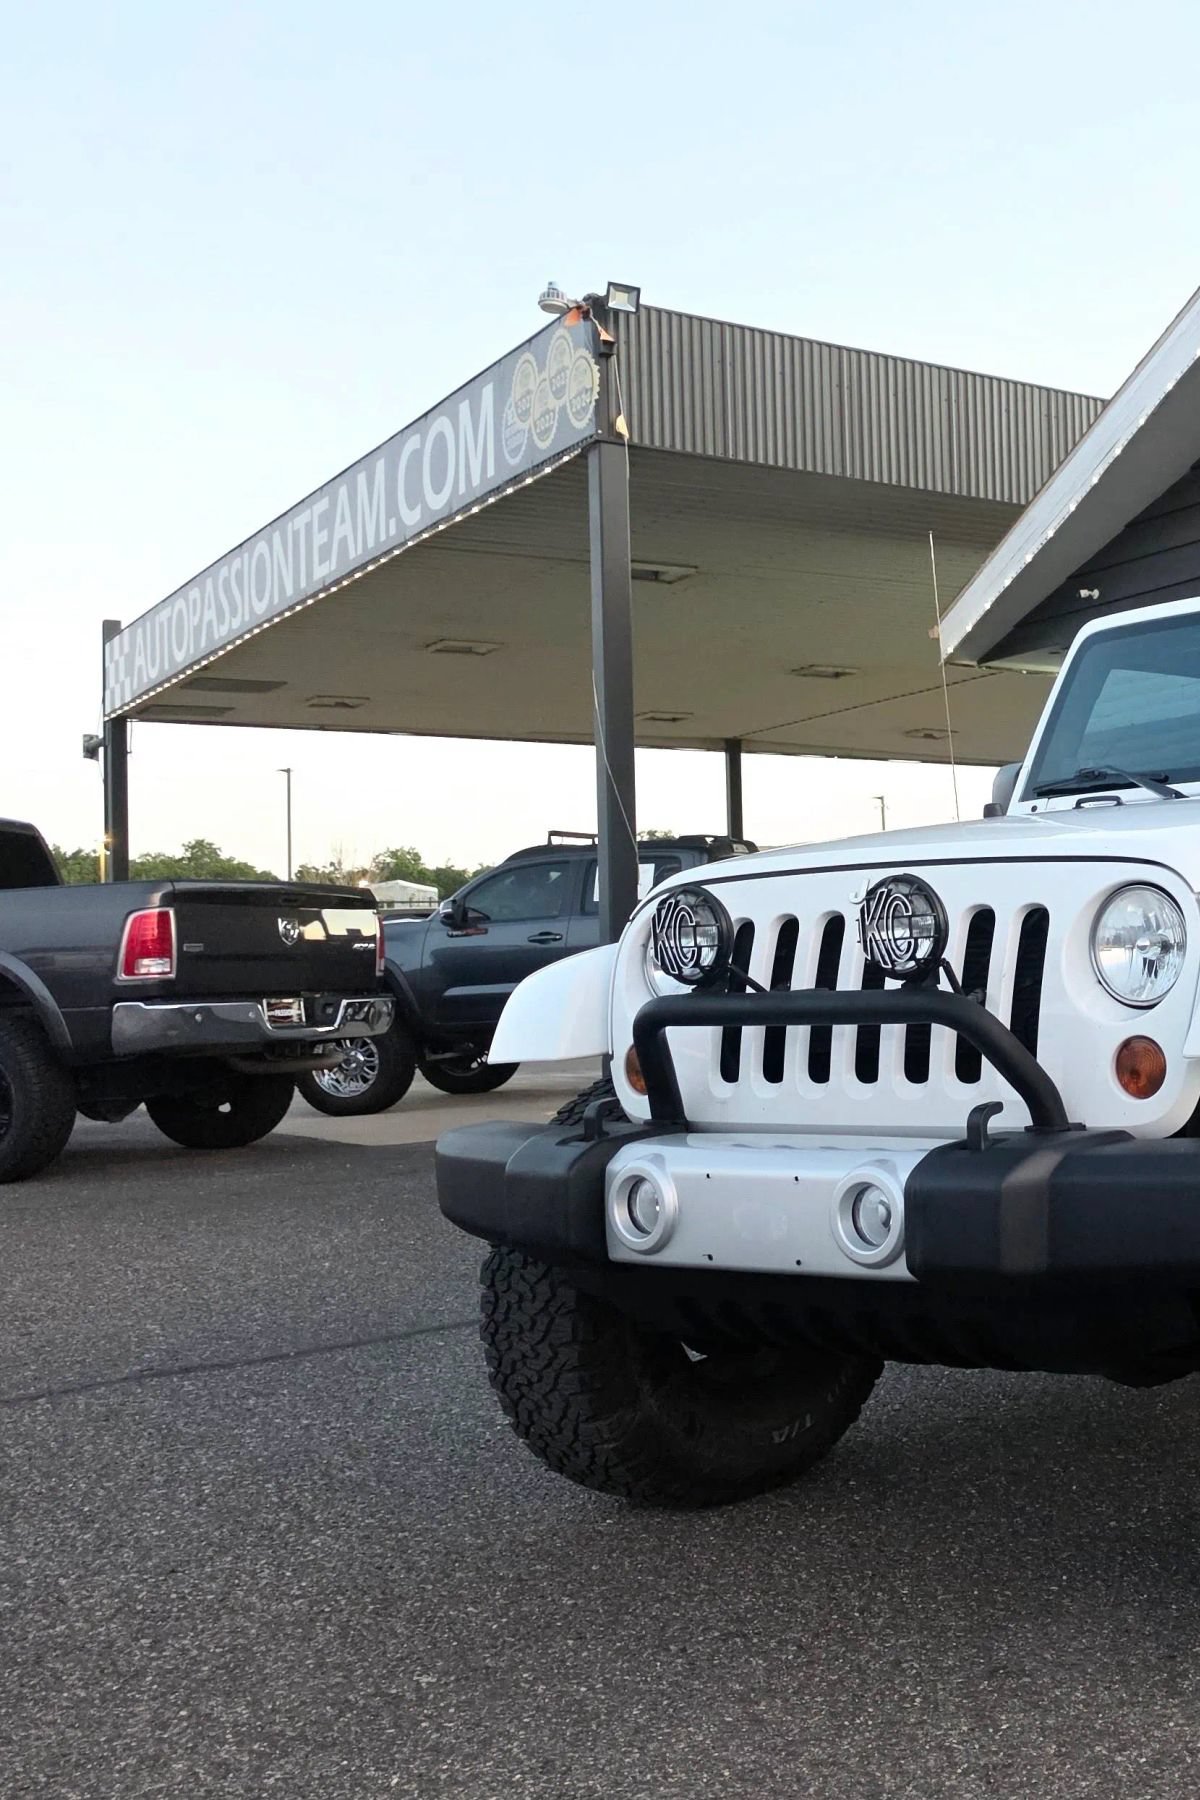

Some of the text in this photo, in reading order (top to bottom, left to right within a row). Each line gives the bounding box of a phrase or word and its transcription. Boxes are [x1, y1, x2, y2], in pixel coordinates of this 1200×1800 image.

[130, 382, 495, 690] AUTOPASSIONTEAM.COM
[650, 898, 698, 975] KC
[860, 888, 915, 968] KC
